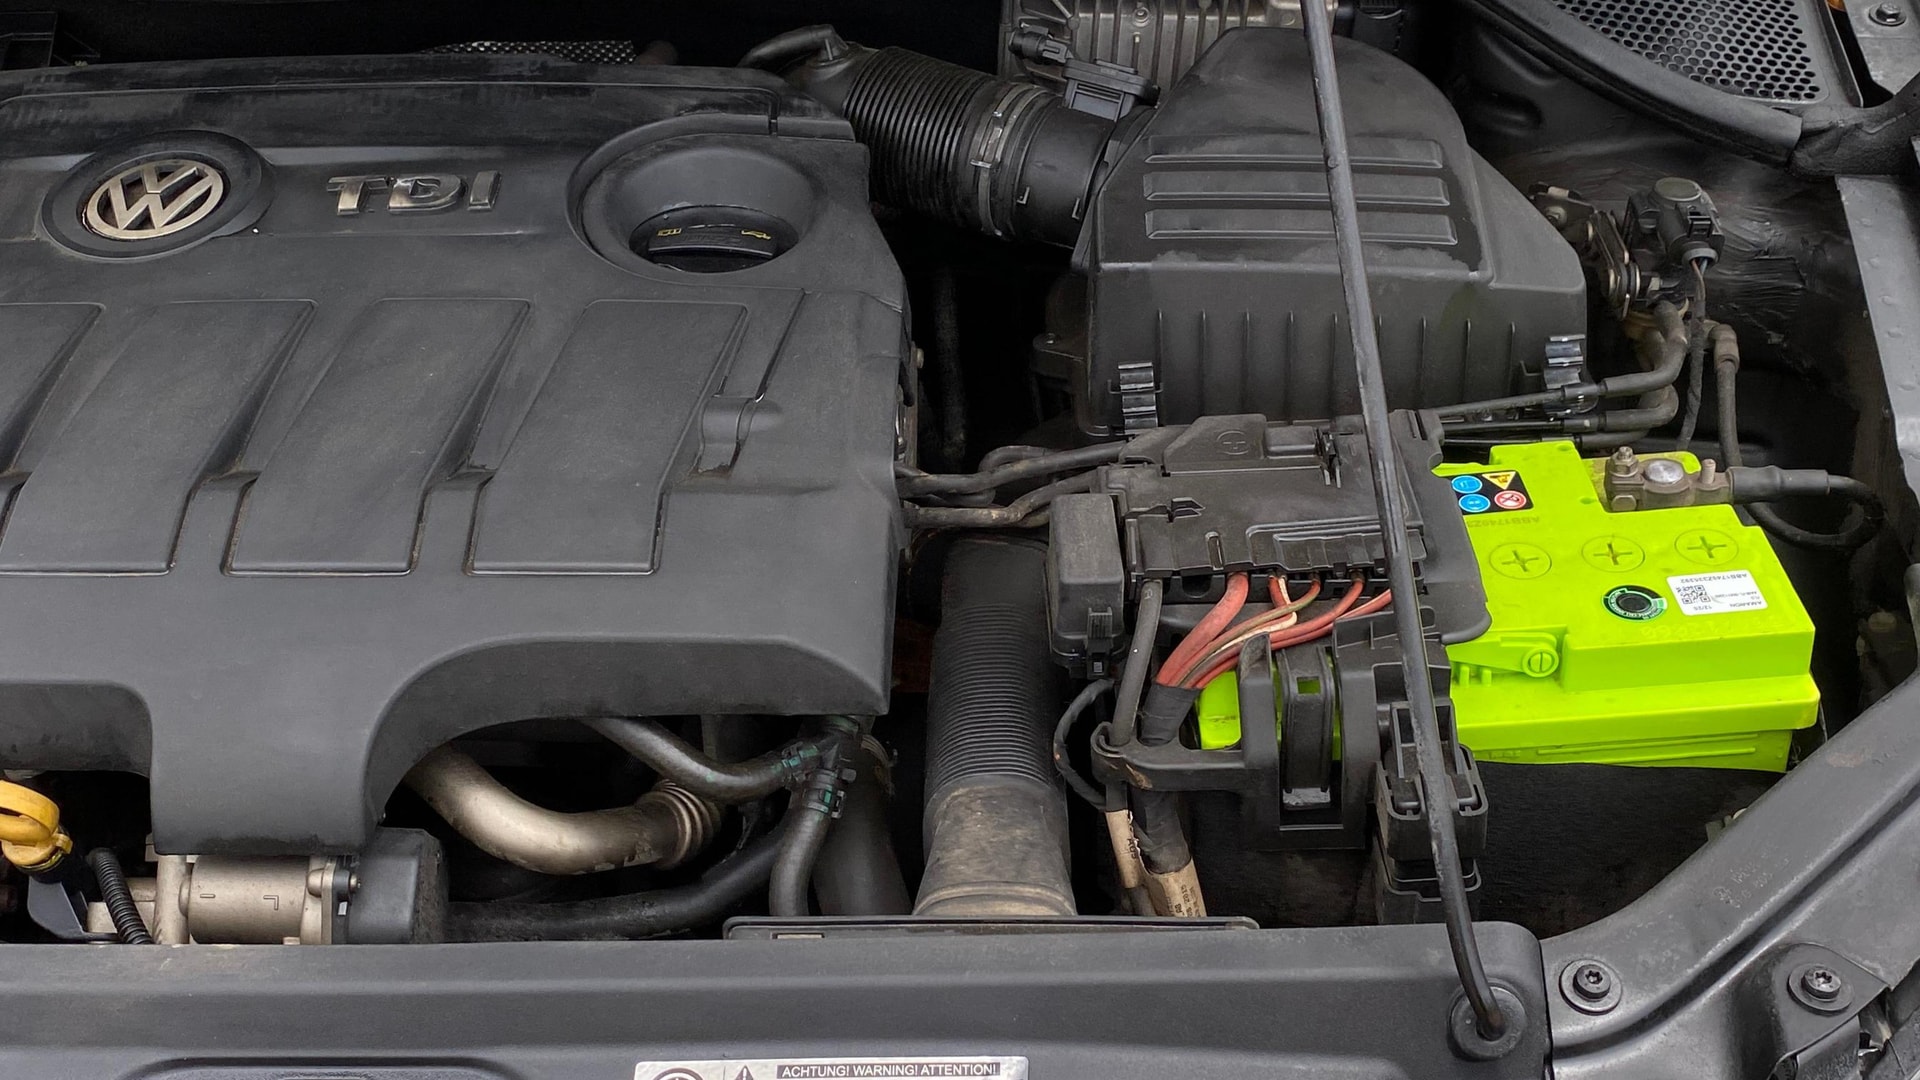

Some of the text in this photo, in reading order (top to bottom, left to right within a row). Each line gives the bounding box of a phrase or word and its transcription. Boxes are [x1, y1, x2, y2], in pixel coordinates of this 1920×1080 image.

[86, 159, 226, 240] VW
[326, 170, 499, 216] TDI
[781, 1063, 997, 1077] ACHTUNG! WARNING! ATTENTION!
